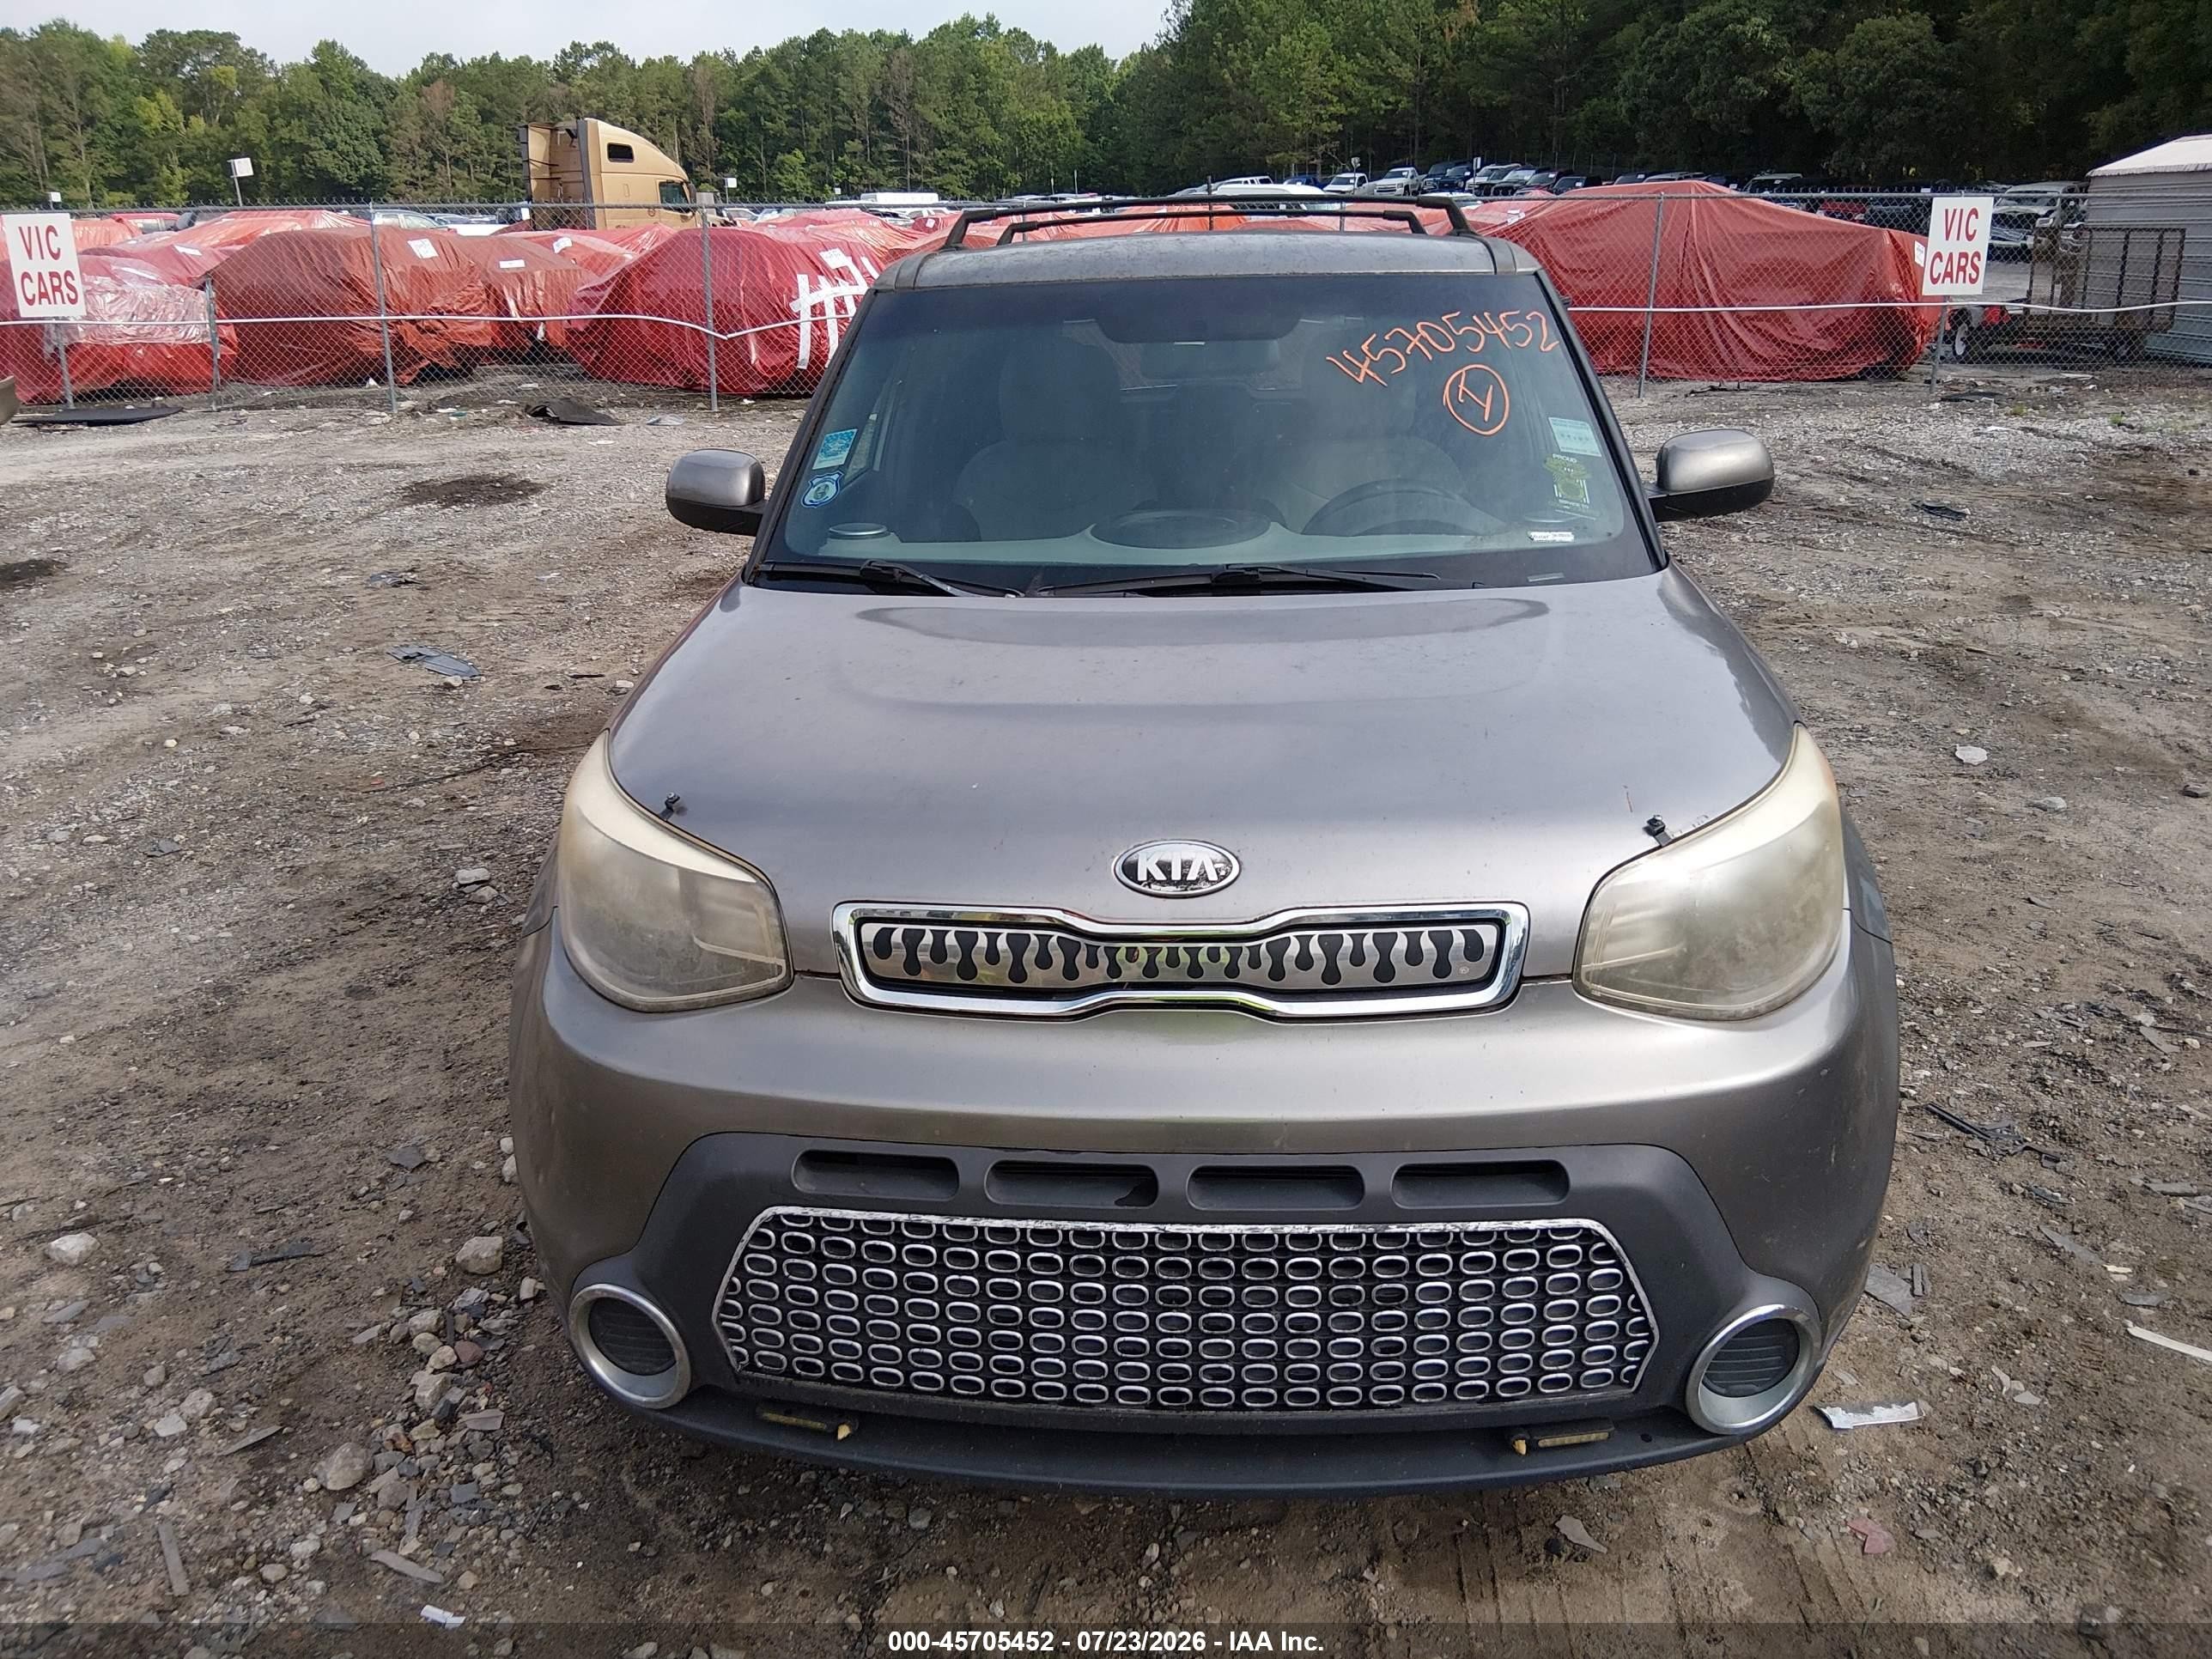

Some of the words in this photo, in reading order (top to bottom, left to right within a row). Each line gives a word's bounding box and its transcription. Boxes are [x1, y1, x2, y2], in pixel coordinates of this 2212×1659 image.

[1944, 208, 1978, 241] VIC
[18, 225, 61, 260] VIC
[1929, 251, 1981, 284] CARS
[21, 270, 79, 307] CARS
[1326, 311, 1559, 386] 45705452
[1137, 851, 1218, 881] KIA
